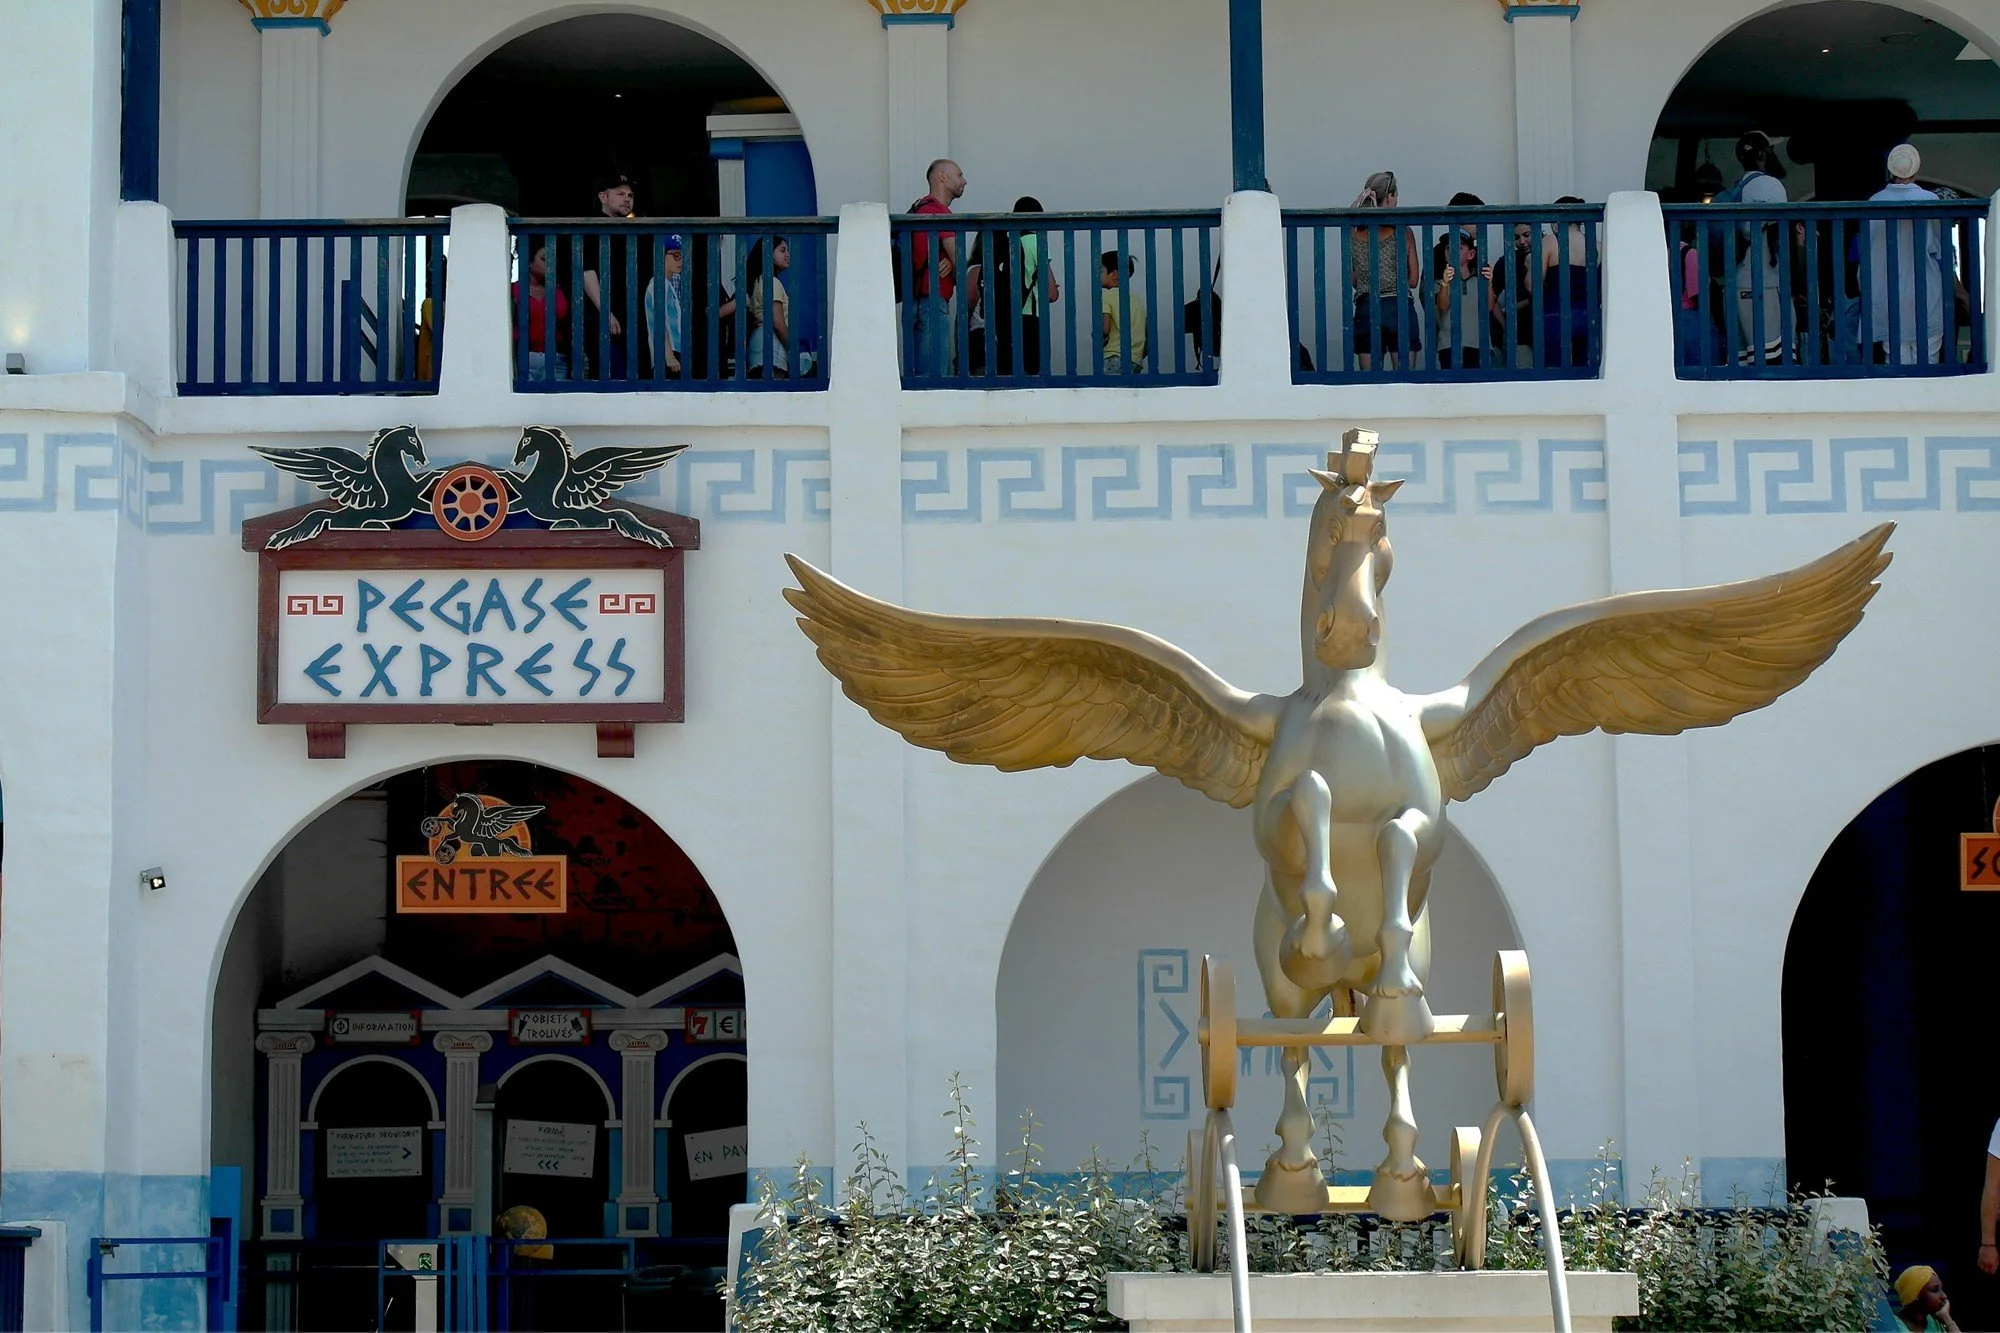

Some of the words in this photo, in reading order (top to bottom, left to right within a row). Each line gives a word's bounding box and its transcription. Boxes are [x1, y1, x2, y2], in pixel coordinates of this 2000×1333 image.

[355, 577, 593, 635] PEGASE
[303, 637, 636, 698] EXPRESS
[406, 868, 557, 901] ENTREE
[352, 1022, 415, 1032] INFORMATION
[690, 1015, 709, 1036] 7
[694, 1150, 713, 1164] EN
